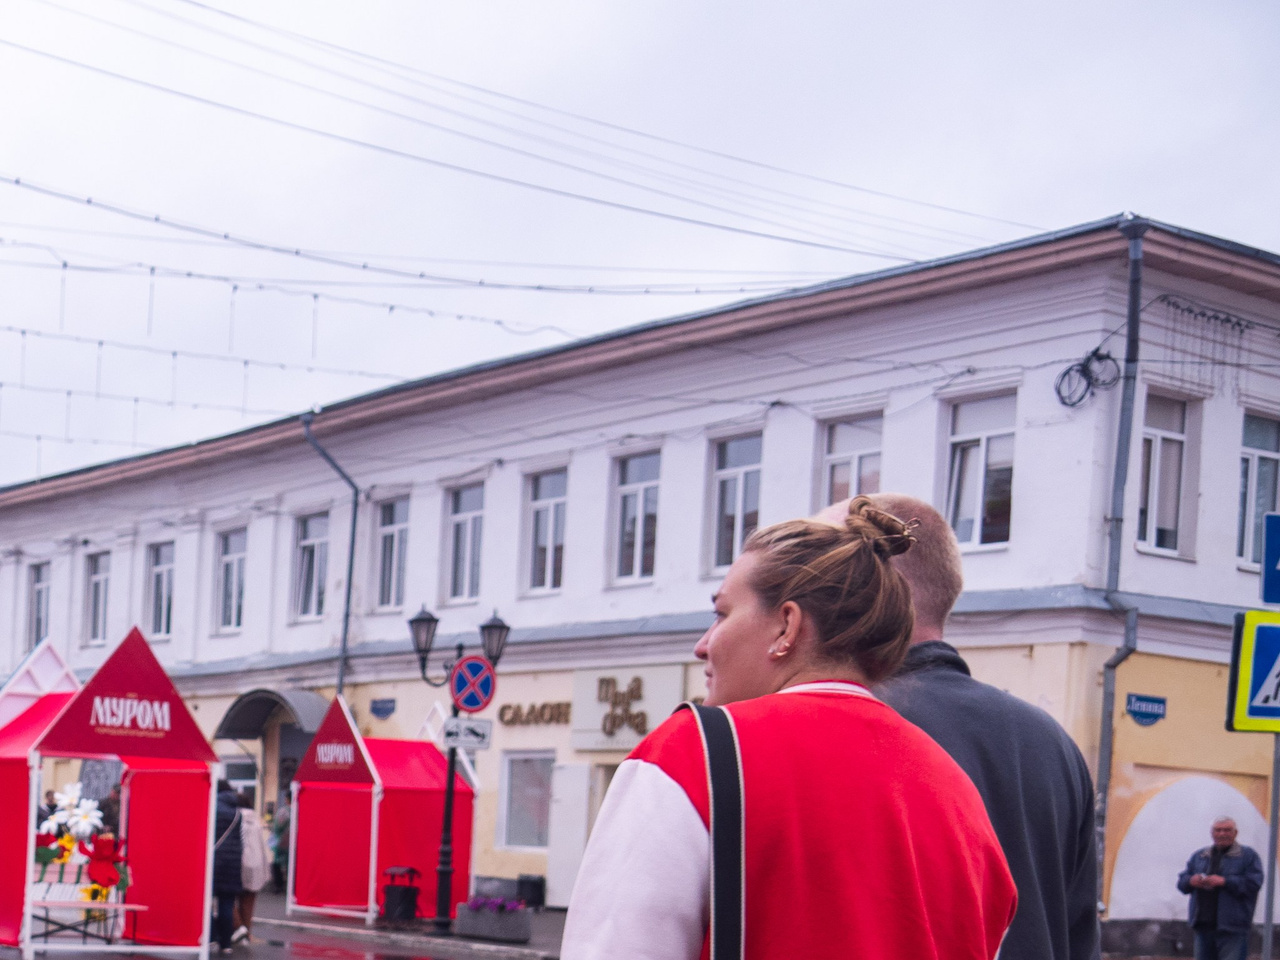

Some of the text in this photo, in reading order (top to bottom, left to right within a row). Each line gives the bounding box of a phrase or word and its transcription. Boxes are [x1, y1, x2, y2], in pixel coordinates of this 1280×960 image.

[89, 695, 171, 732] МУРОМ
[498, 702, 571, 726] САЛОН
[315, 742, 355, 764] МУРОМ
